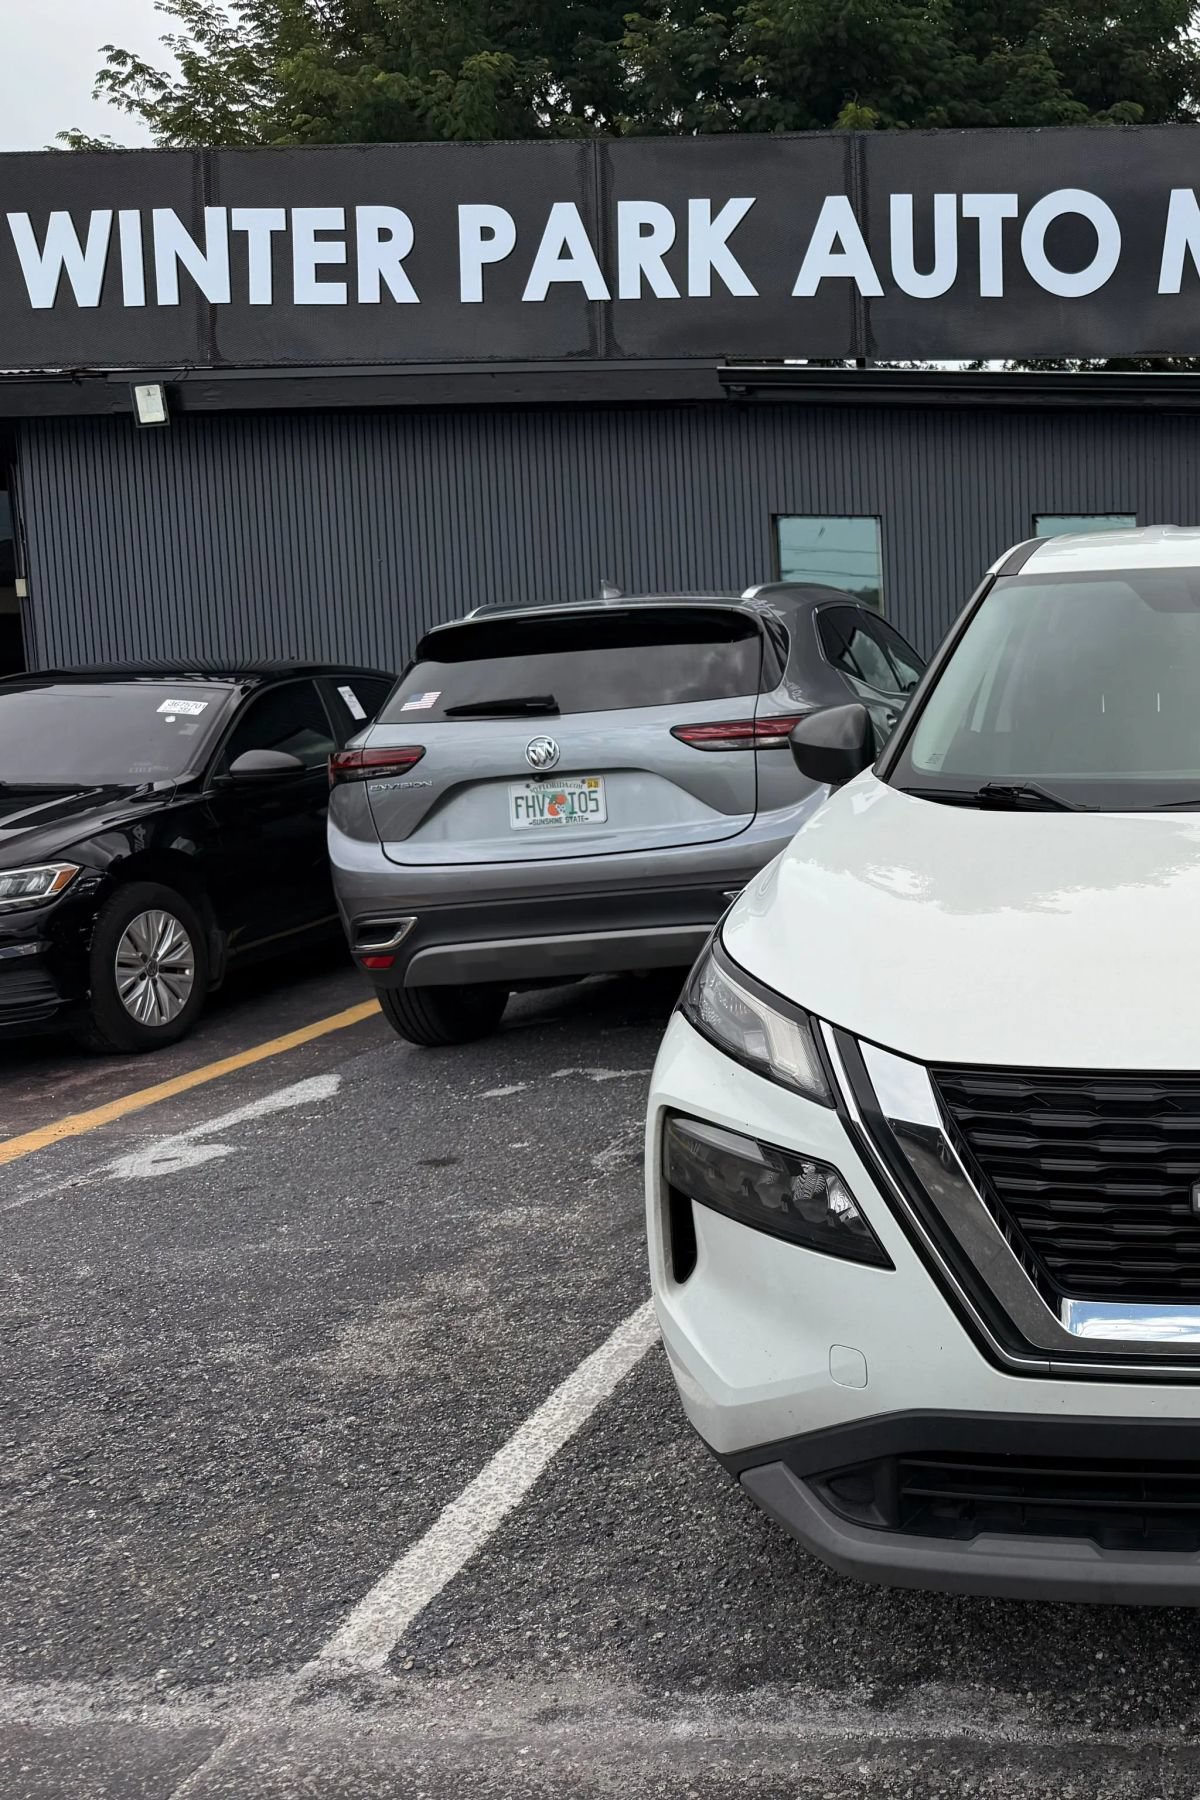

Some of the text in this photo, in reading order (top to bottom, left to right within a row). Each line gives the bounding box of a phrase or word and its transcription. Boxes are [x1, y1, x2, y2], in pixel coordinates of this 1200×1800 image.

[6, 206, 420, 309] WINTER
[458, 197, 760, 303] PARK
[791, 188, 1122, 298] AUTO
[370, 780, 433, 792] ENVISION
[532, 815, 585, 825] SUNSHINE STATE
